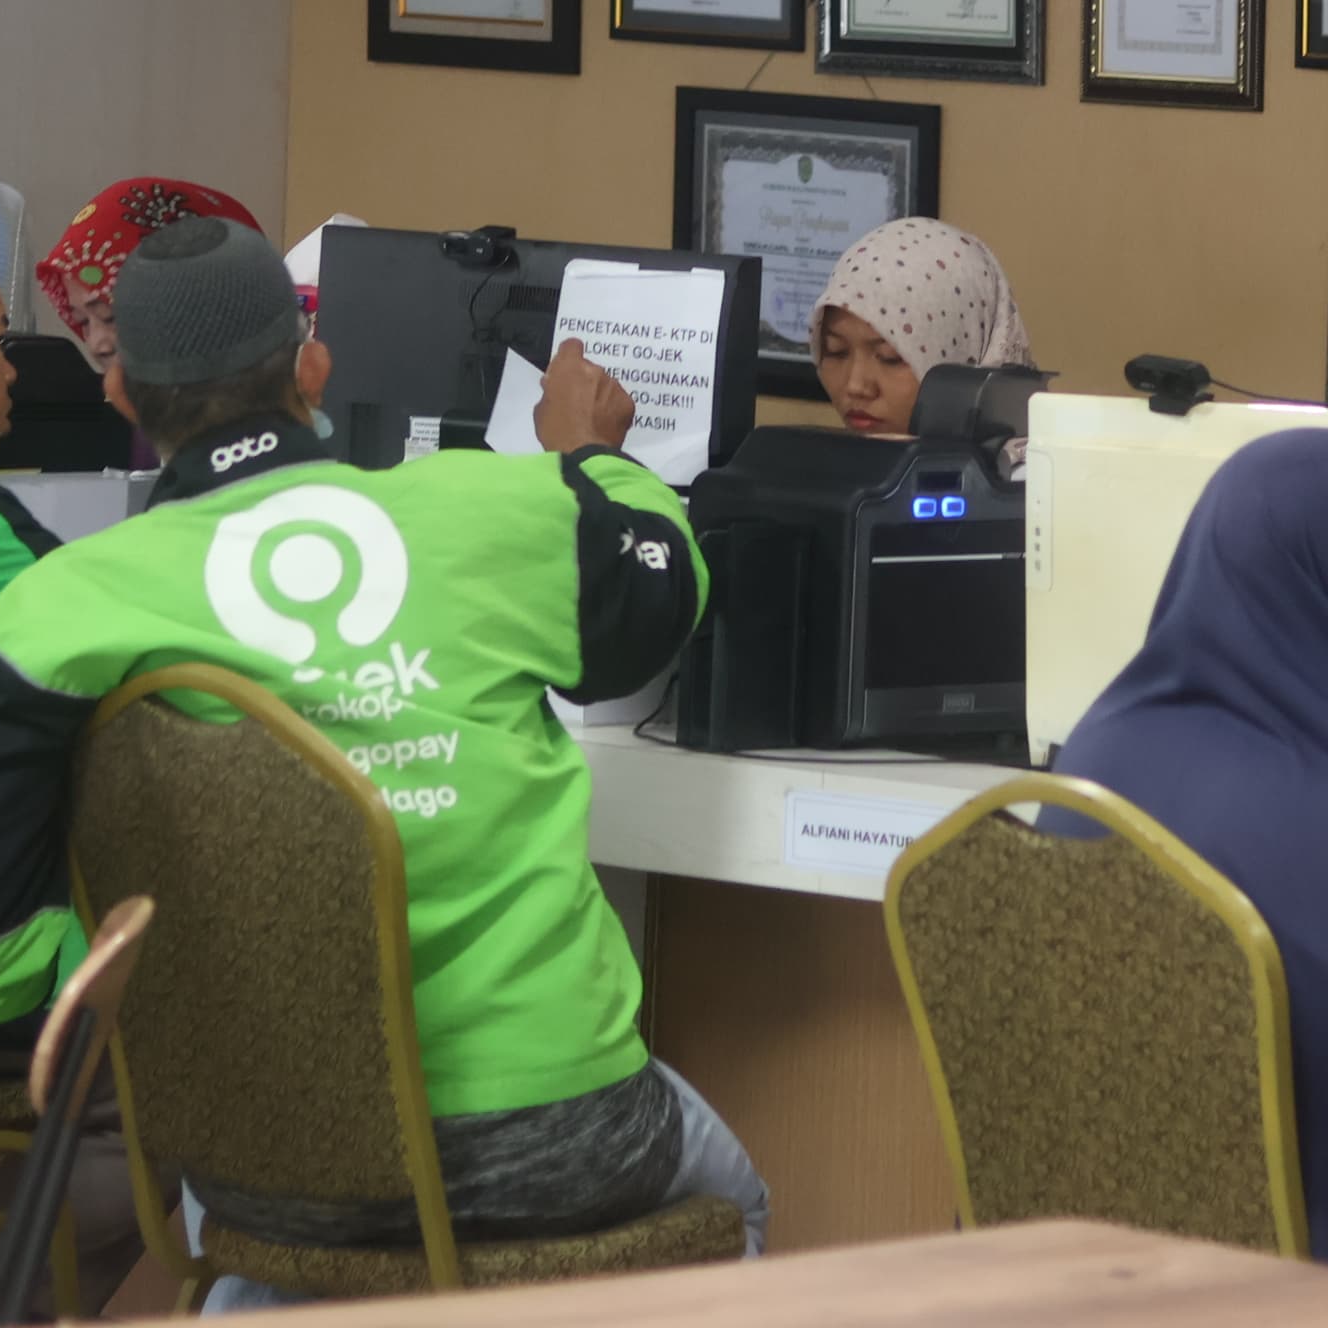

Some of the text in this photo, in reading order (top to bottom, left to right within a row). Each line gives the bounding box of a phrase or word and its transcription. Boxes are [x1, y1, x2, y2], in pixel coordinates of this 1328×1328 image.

[559, 317, 650, 338] PENCETAKAN
[670, 328, 697, 343] KTP
[699, 330, 714, 344] DI
[584, 341, 683, 363] LOKET GO-JEK
[630, 390, 695, 410] GO-JEK!!!
[211, 431, 278, 473] goto
[346, 729, 460, 775] gopay
[801, 823, 850, 841] ALFIANI
